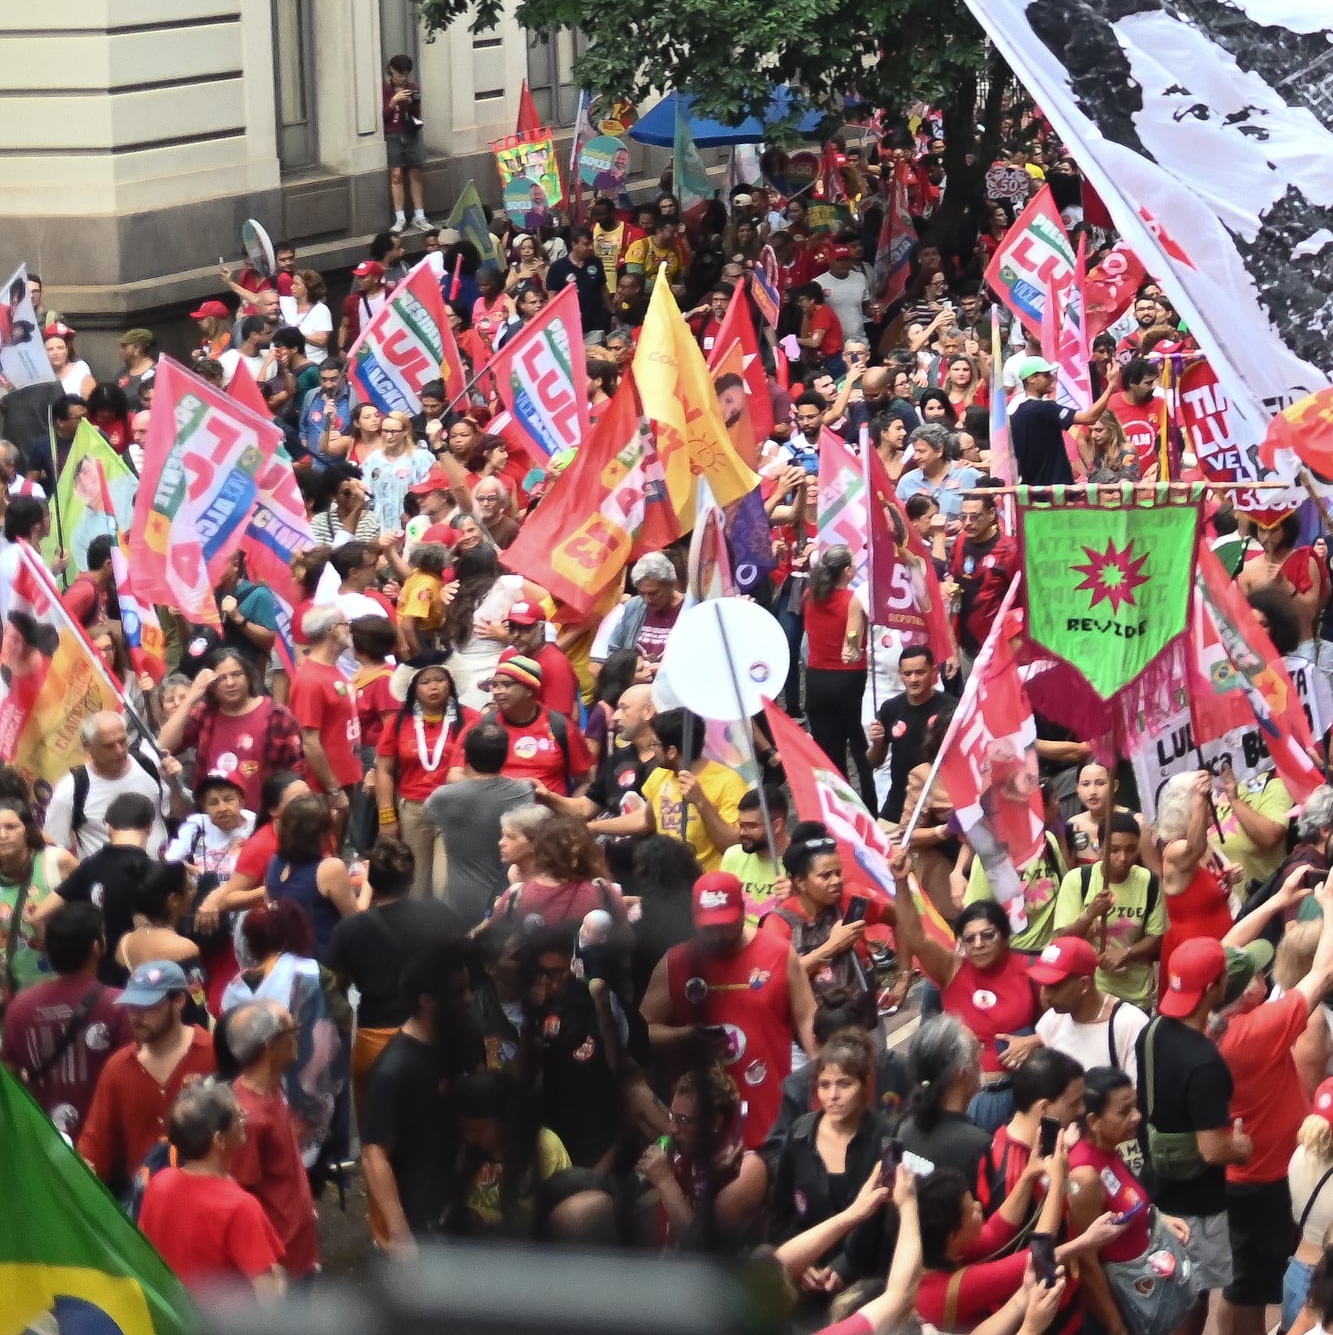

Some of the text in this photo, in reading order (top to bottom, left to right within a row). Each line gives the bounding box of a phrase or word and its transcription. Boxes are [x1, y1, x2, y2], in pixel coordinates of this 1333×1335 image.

[371, 308, 432, 393] LUL
[522, 340, 582, 444] LUL
[1190, 414, 1238, 459] LU
[1206, 450, 1242, 471] VE
[1067, 617, 1148, 639] REVIDE
